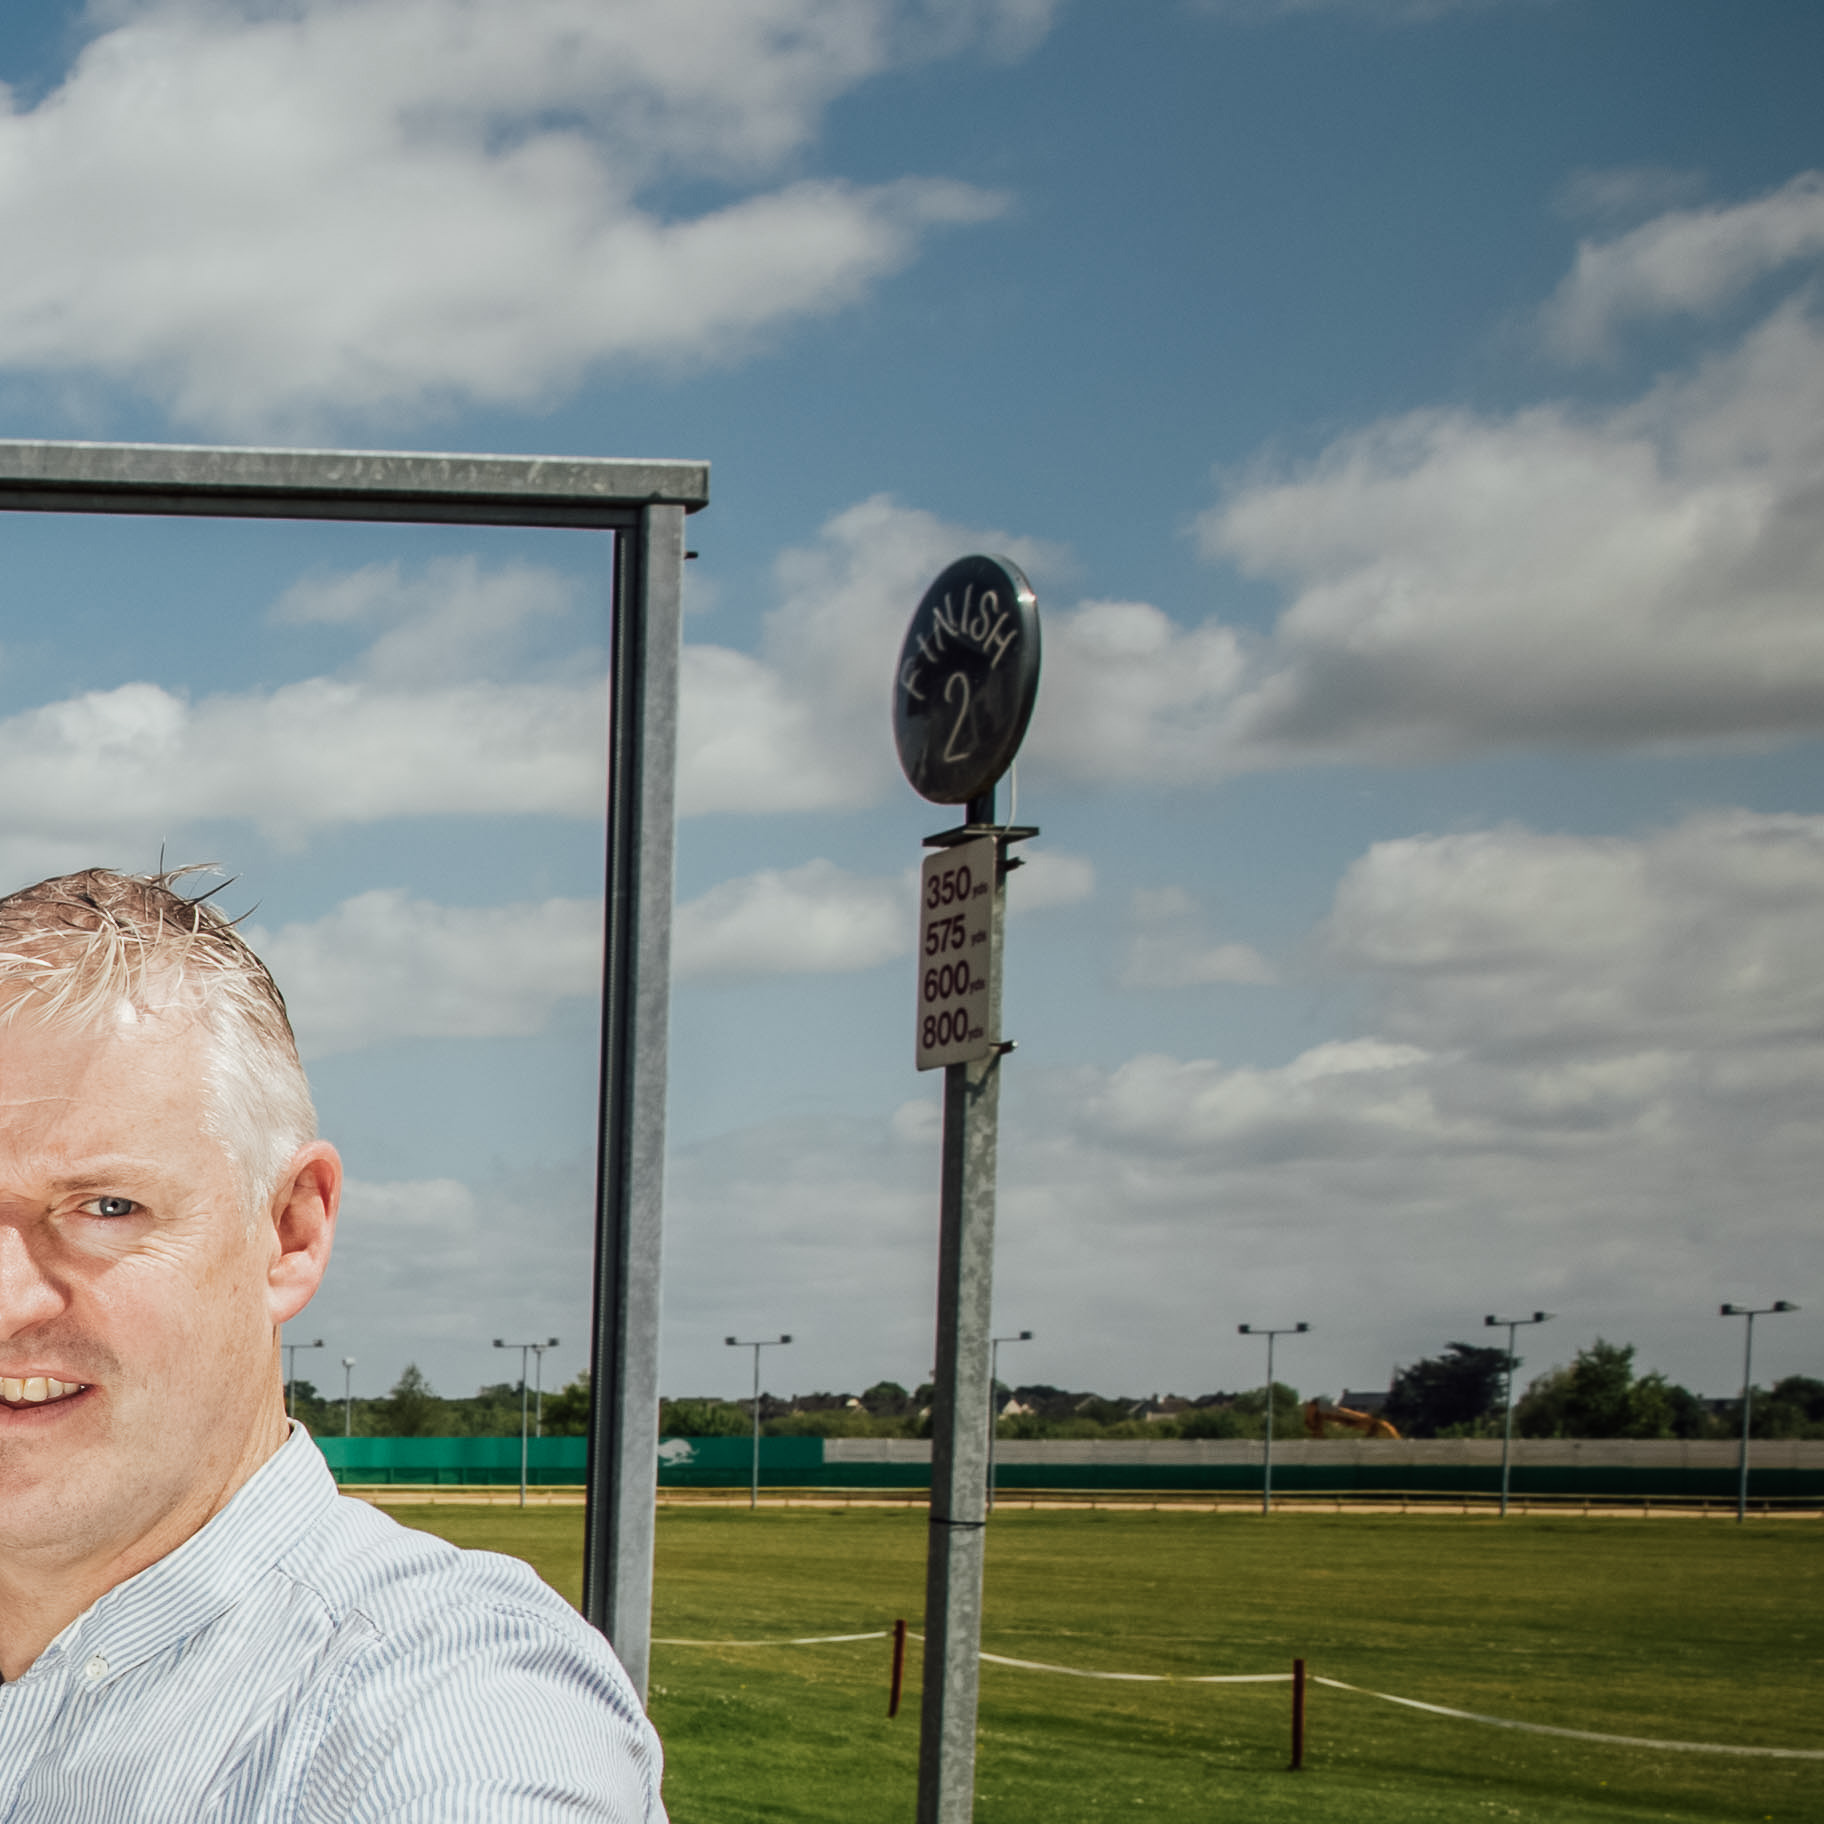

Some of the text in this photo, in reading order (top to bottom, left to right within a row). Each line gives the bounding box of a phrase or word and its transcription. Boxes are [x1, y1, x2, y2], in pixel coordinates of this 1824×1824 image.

[902, 584, 1018, 700] FINISH
[944, 671, 970, 763] 2
[926, 865, 972, 910] 350
[925, 913, 966, 956] 575
[923, 959, 970, 1003] 600
[922, 1006, 968, 1050] 800
